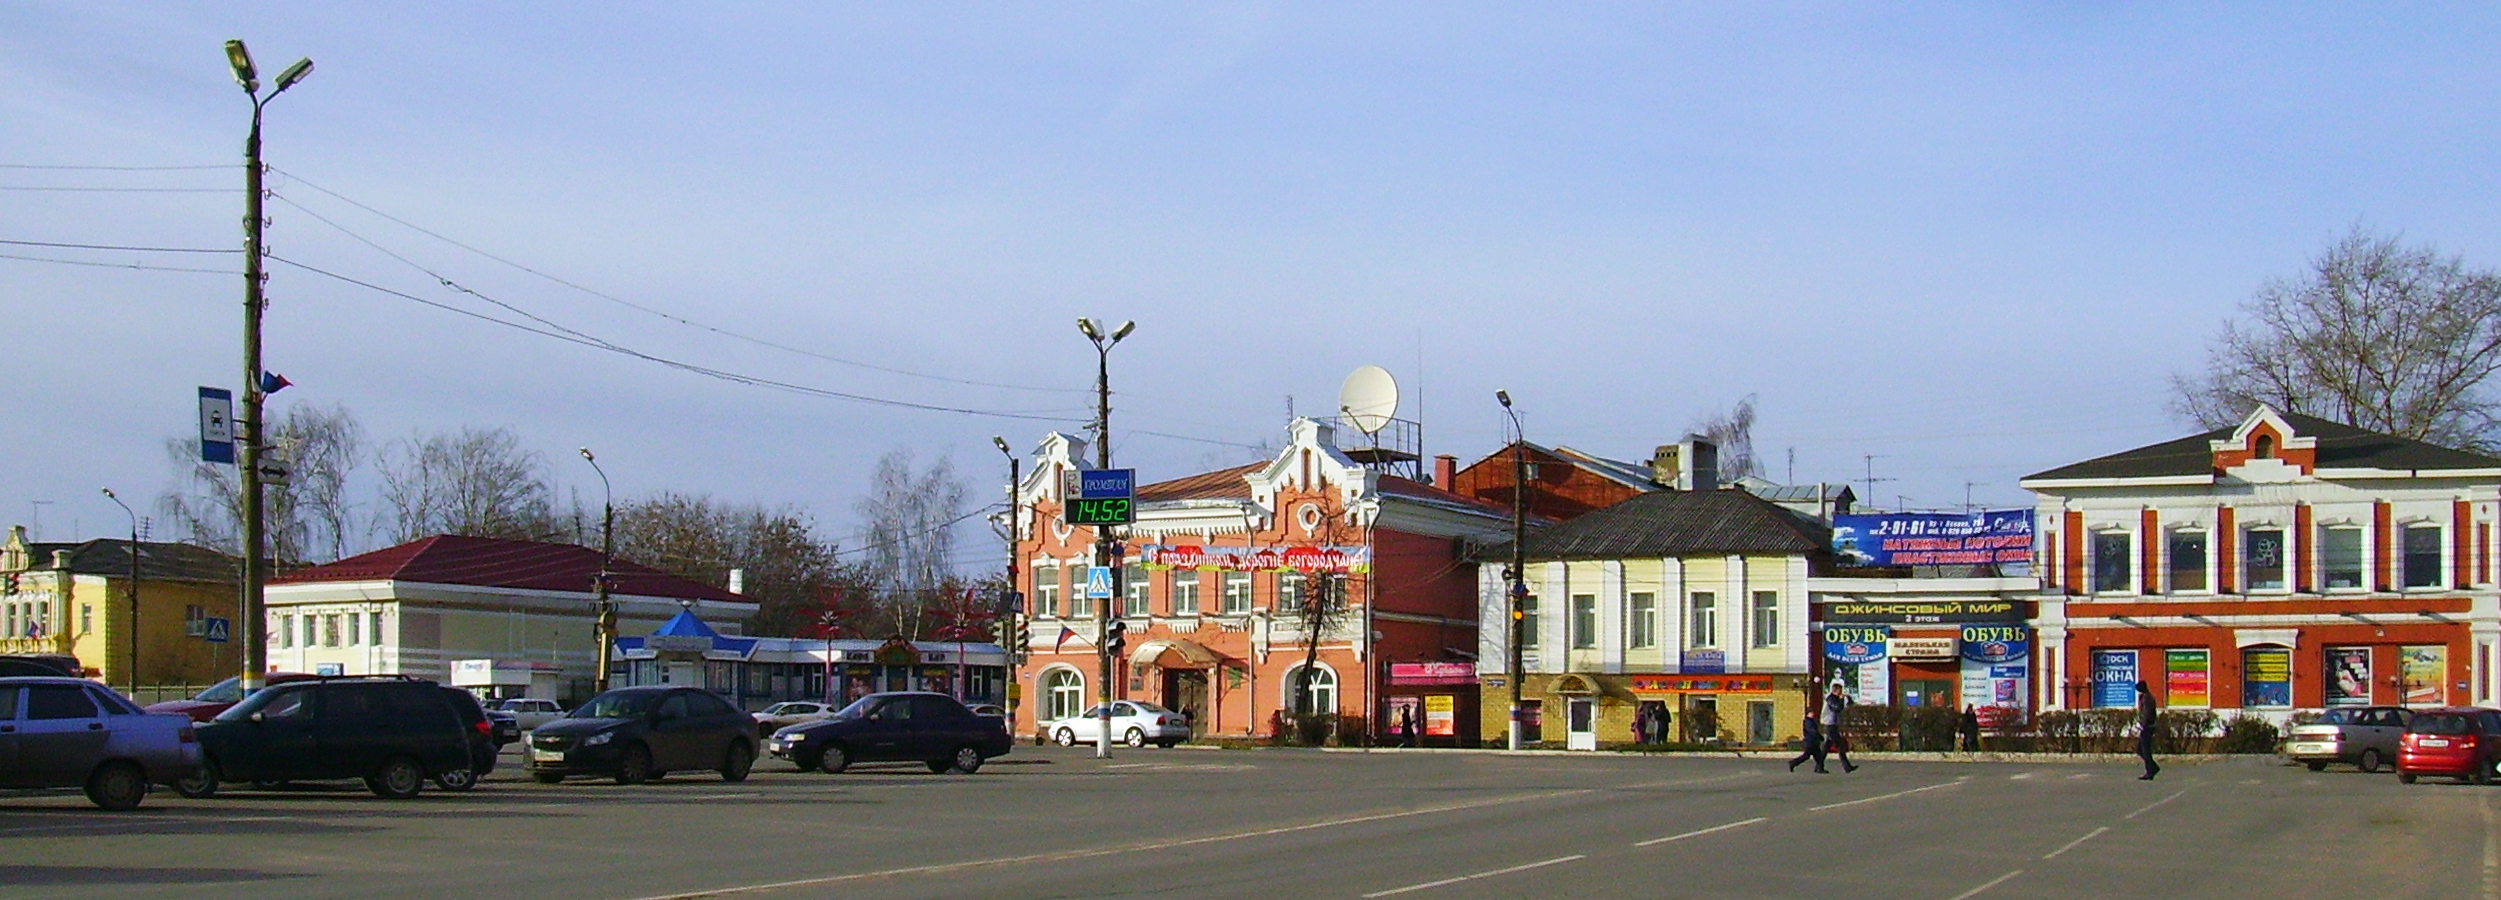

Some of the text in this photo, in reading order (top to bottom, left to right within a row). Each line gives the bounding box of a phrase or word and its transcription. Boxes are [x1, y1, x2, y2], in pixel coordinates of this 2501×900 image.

[1078, 500, 1128, 521] 14.52
[1879, 520, 1925, 535] 2-91-61
[1148, 547, 1158, 564] С
[1835, 601, 2012, 614] ДЖИНСОВЫЙ МИР
[1905, 614, 1912, 622] 2
[1825, 628, 1887, 643] ОБУВЬ
[1963, 627, 2025, 642] ОБУВЬ
[2095, 670, 2134, 682] ОКНА
